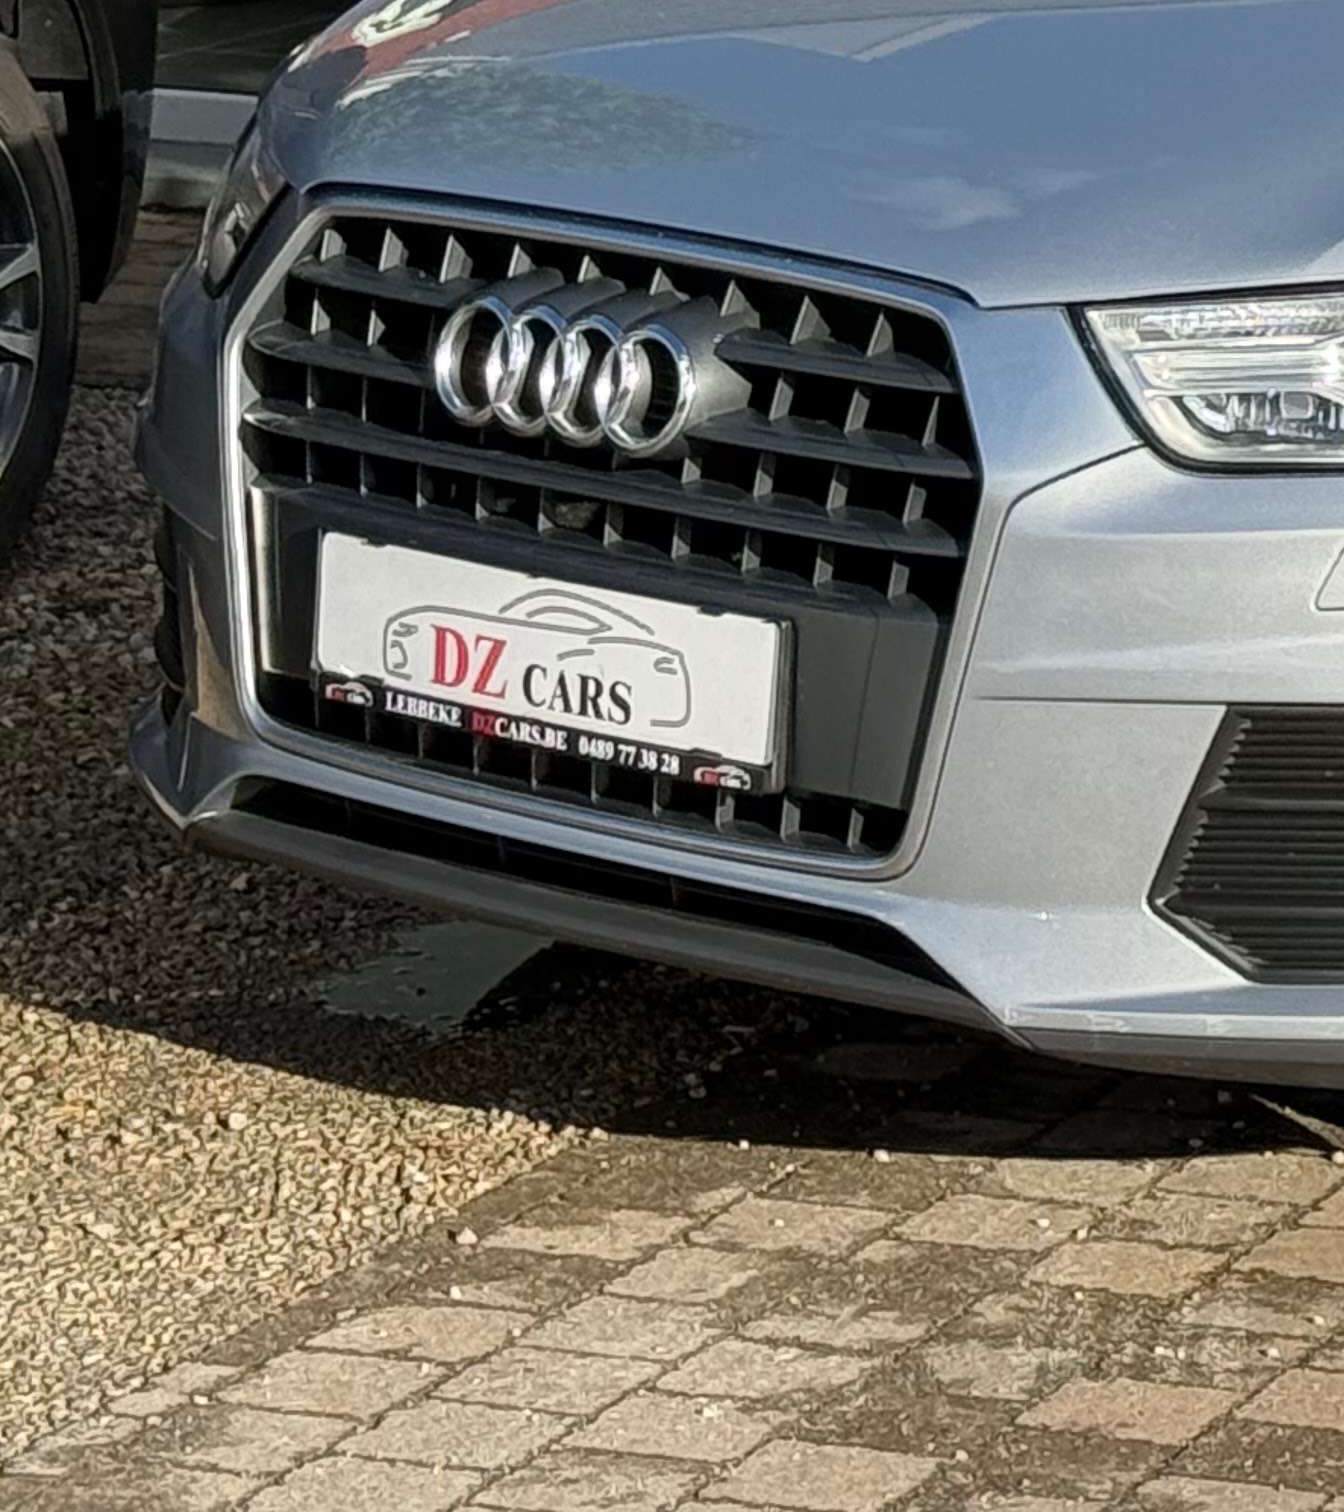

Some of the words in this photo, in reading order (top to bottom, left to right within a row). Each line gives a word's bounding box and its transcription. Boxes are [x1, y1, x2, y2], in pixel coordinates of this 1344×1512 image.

[429, 623, 509, 700] DZ
[522, 663, 633, 726] CARS
[384, 690, 463, 728] LEBBEKE
[471, 710, 568, 751] DZCARS.BE
[578, 735, 615, 760] 0489
[617, 744, 638, 766] 77
[637, 748, 659, 771] 38
[659, 753, 681, 775] 28
